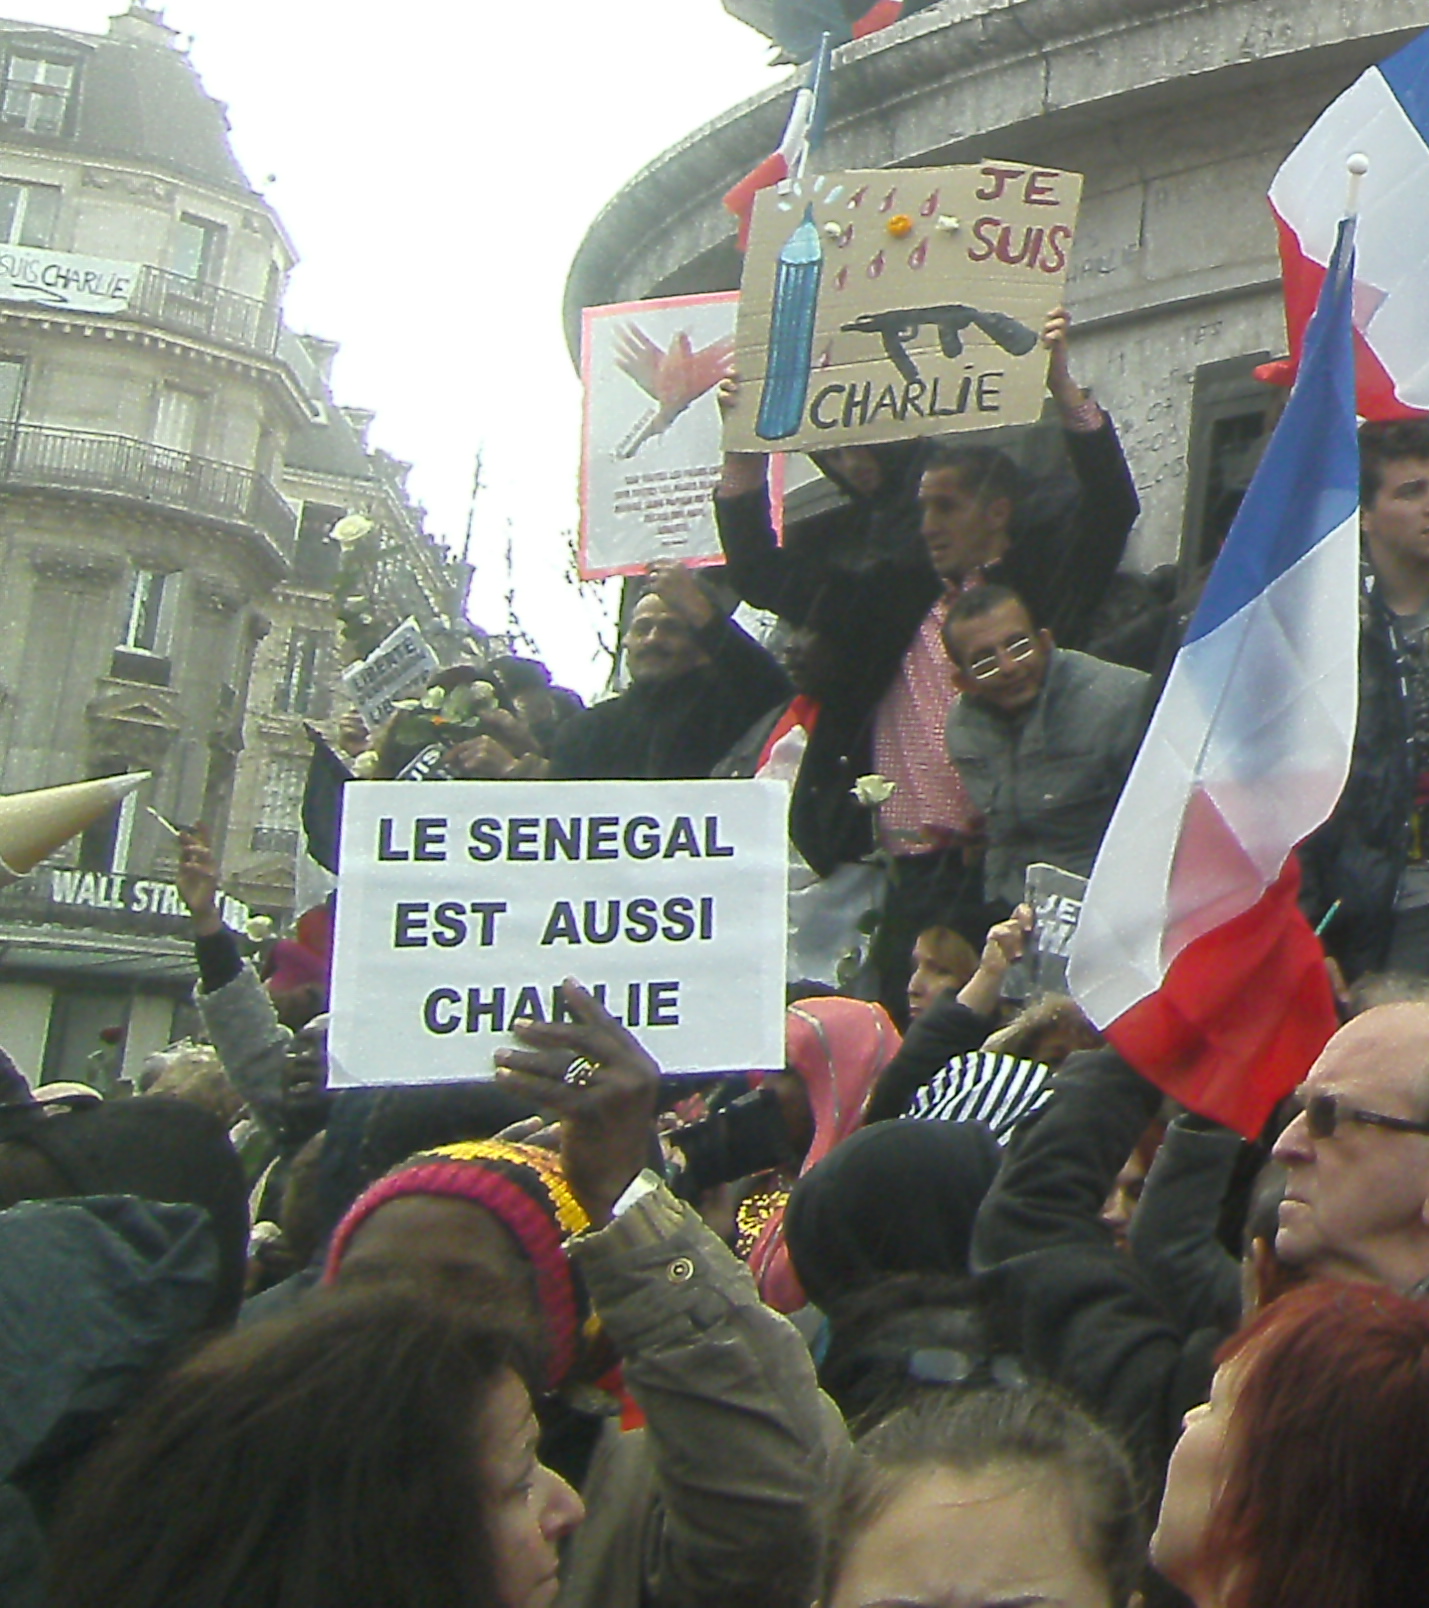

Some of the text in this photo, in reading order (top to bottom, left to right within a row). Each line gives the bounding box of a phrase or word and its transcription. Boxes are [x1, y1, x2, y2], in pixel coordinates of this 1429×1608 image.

[975, 166, 1061, 205] JE
[967, 216, 1072, 273] SUIS
[41, 263, 131, 300] CHARLIE
[378, 815, 735, 862] LE SENEGAL
[52, 868, 127, 910] WALL
[1035, 893, 1083, 923] JE
[393, 896, 714, 948] EST AUSSI
